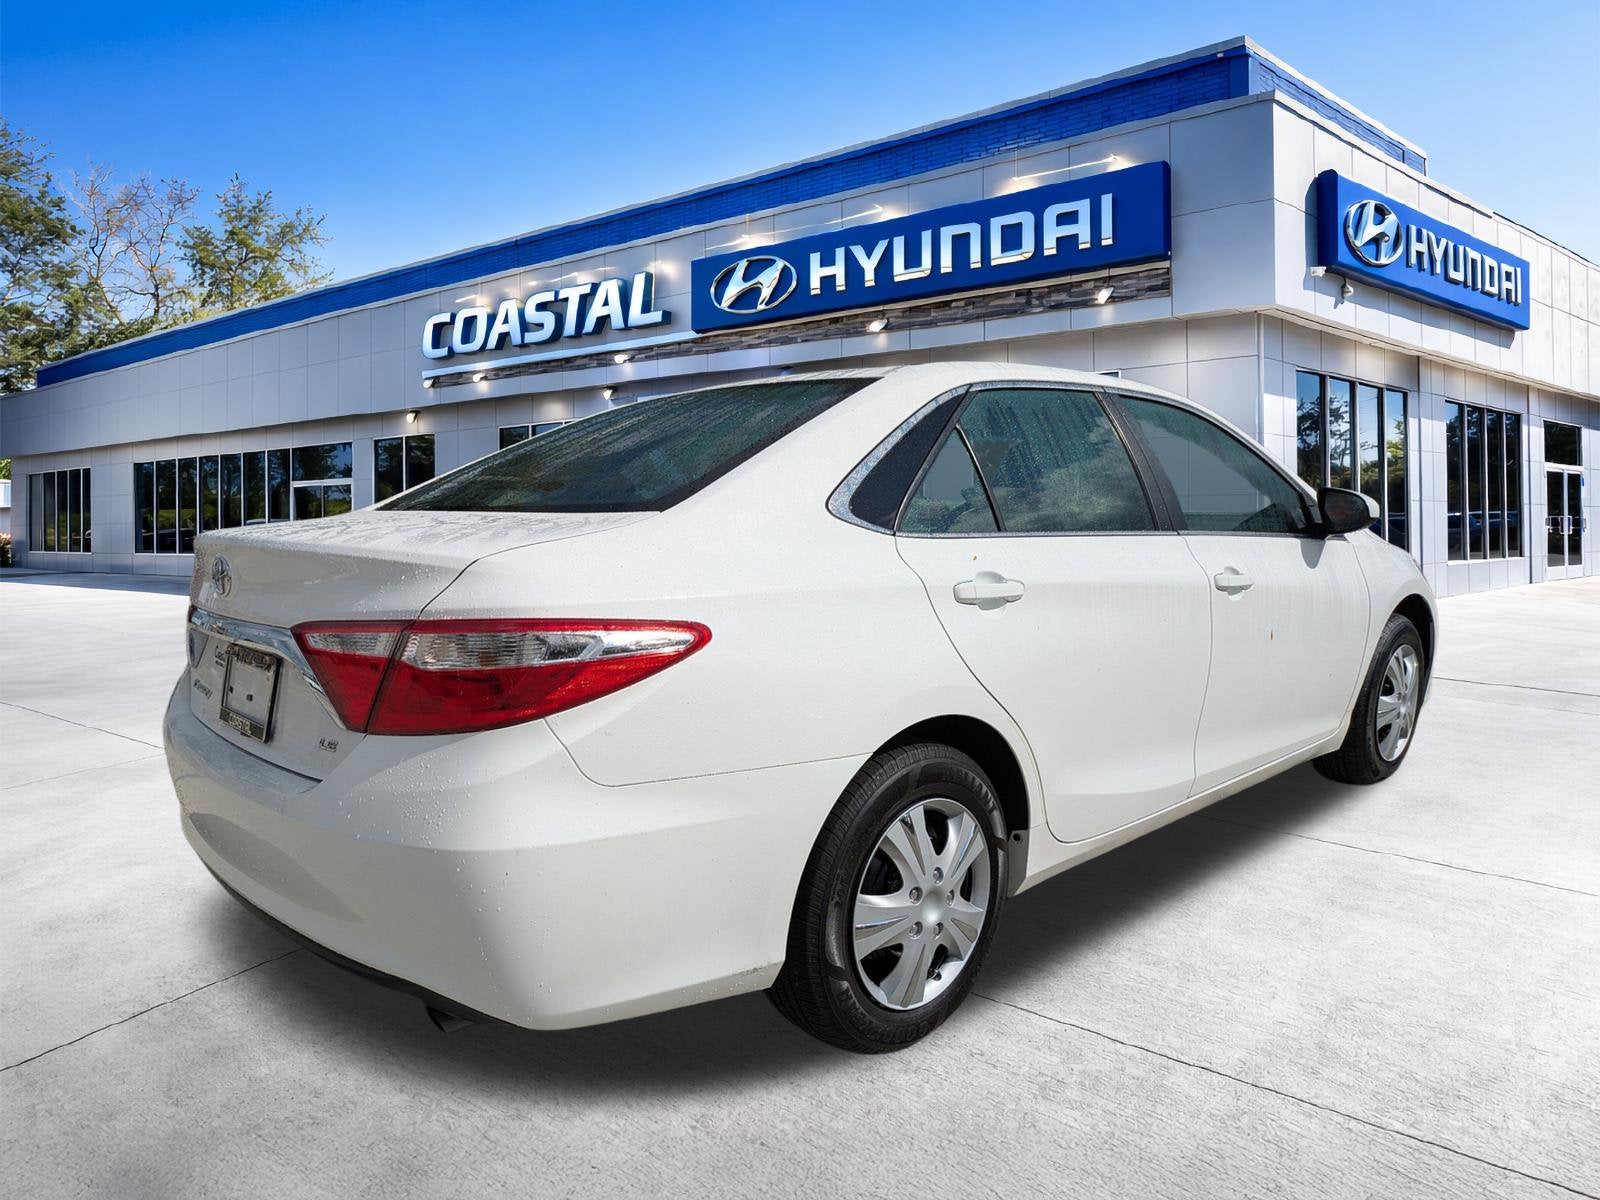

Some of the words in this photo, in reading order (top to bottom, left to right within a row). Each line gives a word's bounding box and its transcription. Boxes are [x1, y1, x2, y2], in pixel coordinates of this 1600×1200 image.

[809, 193, 1114, 296] HYUNDAI
[1405, 224, 1522, 307] HYUNDAI
[422, 270, 672, 360] COASTAL
